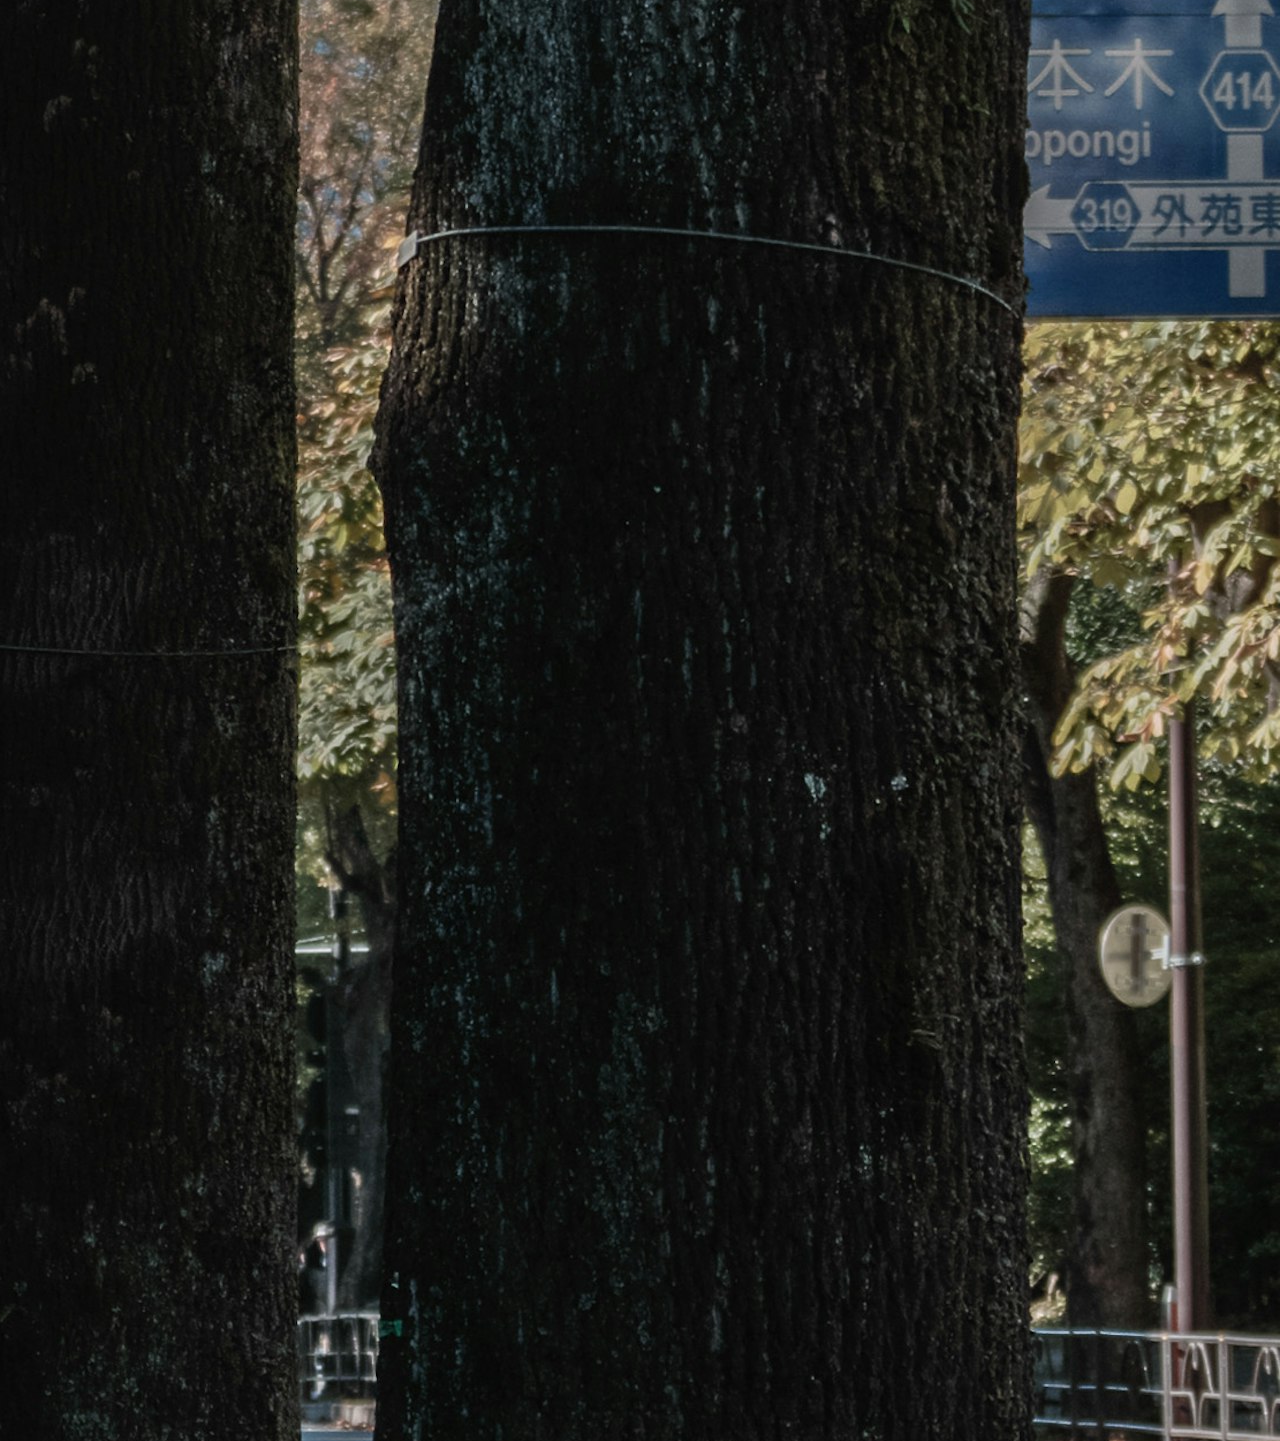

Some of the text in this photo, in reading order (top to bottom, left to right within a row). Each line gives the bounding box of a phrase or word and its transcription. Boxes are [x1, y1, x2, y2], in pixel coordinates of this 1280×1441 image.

[1213, 71, 1276, 111] 414
[1080, 197, 1133, 234] 319
[1151, 193, 1280, 238] 外苑東
